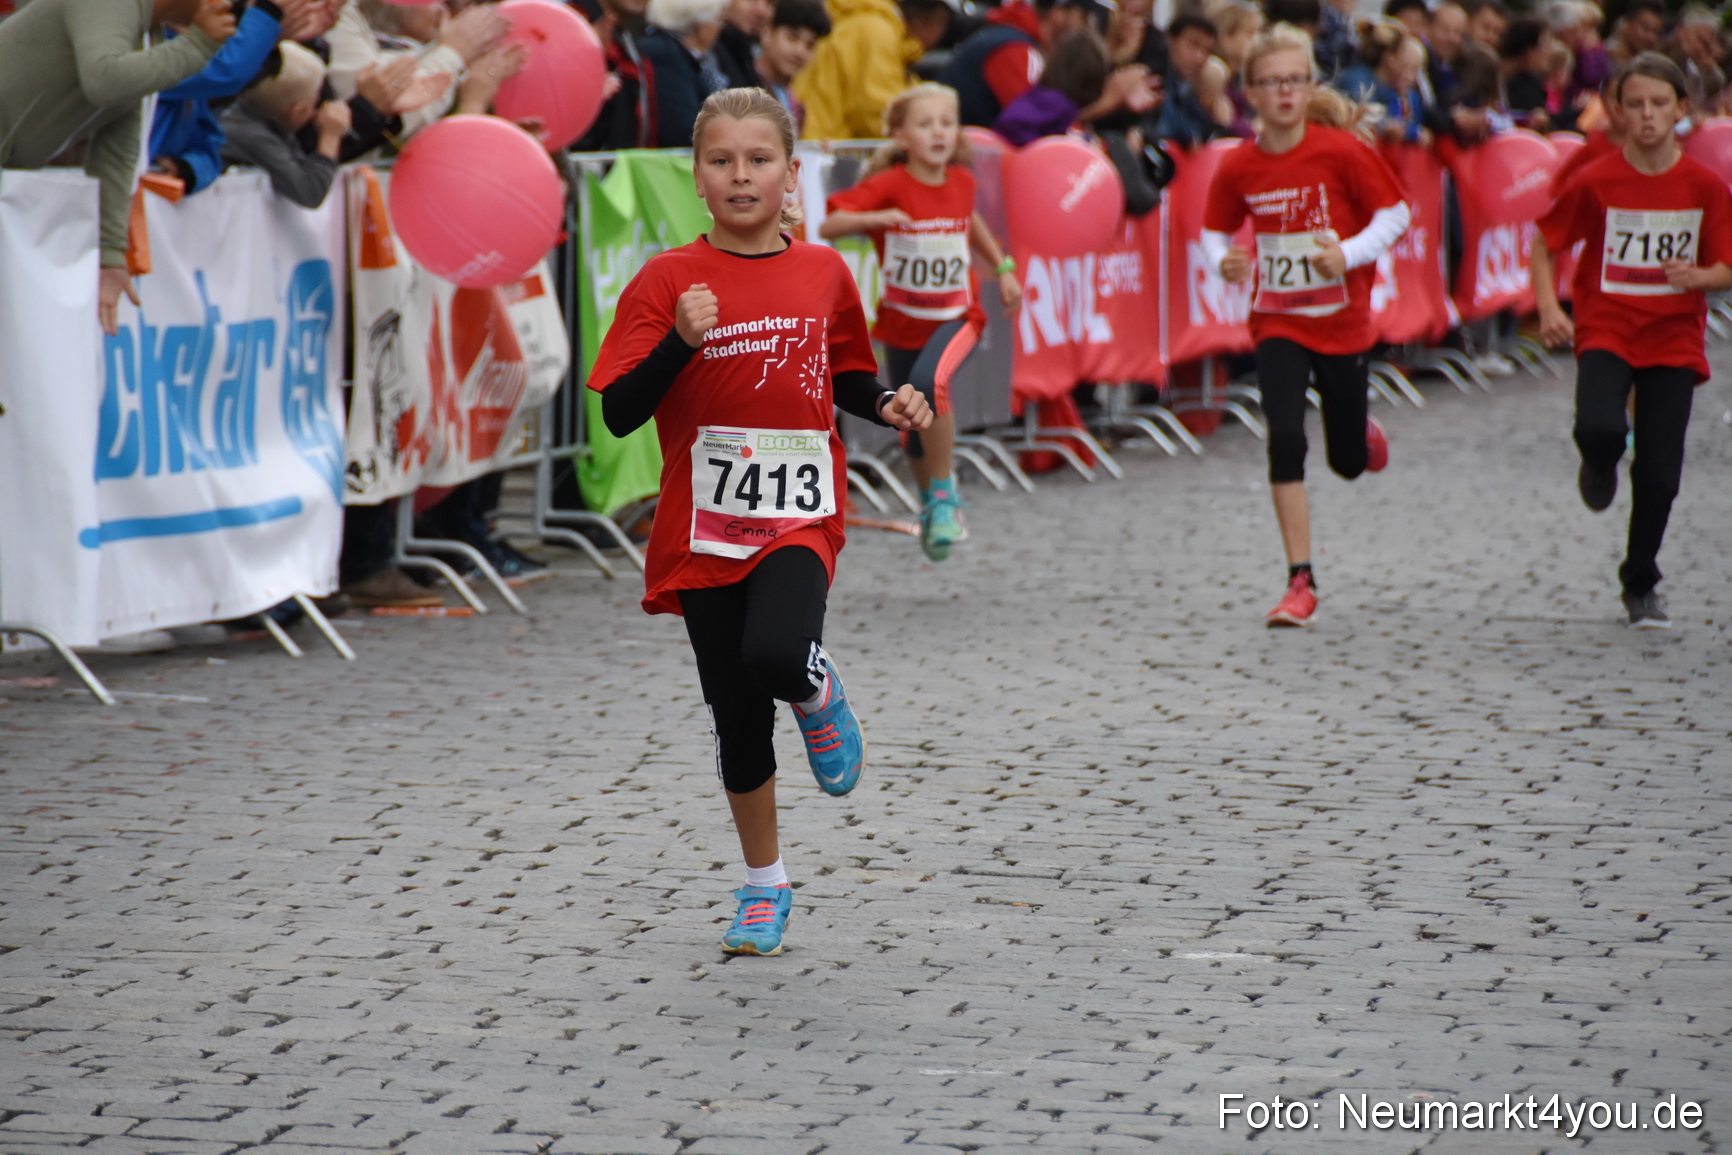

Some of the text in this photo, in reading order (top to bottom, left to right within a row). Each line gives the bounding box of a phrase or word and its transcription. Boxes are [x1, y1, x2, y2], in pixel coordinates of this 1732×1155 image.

[1616, 231, 1692, 262] 7182
[893, 255, 963, 287] 7092
[1264, 254, 1312, 287] 721
[703, 316, 798, 341] Neumarkter
[703, 335, 780, 360] Stadtlauf
[703, 440, 748, 451] NeuerMark
[757, 434, 822, 451] BOCK
[708, 457, 821, 512] 7413
[724, 520, 778, 538] Emma
